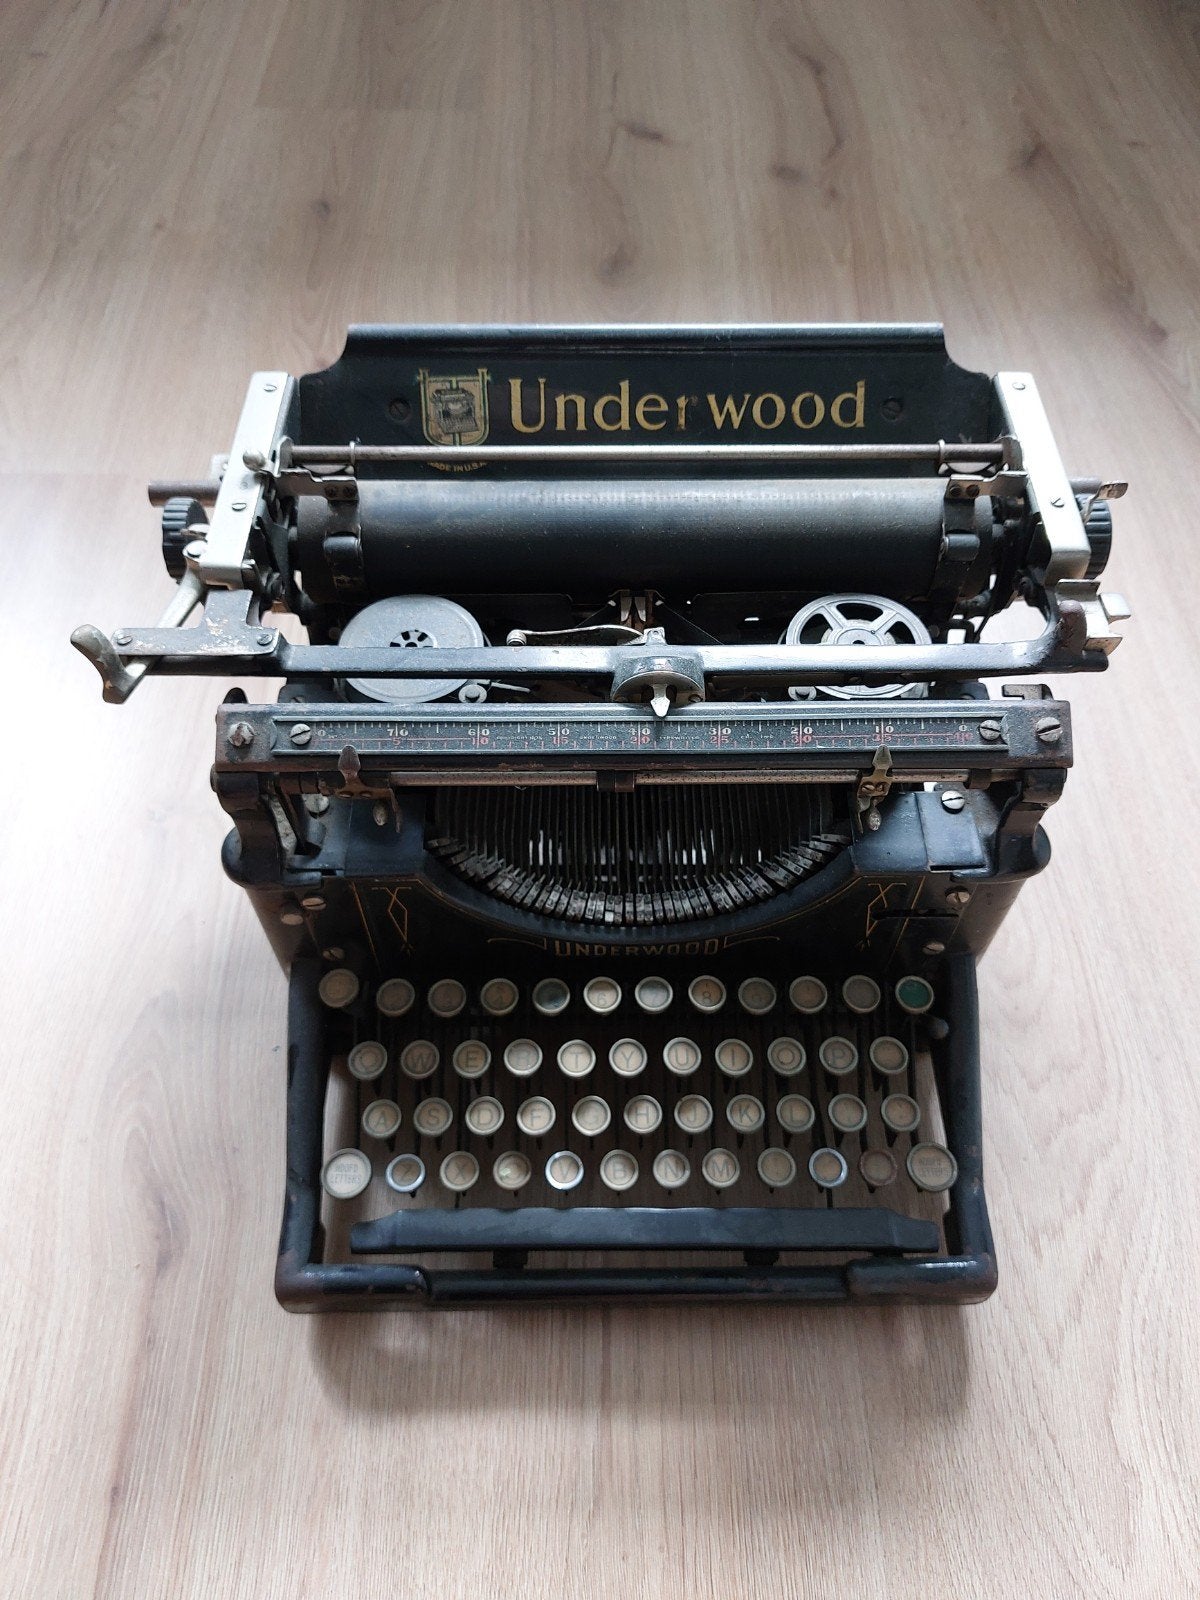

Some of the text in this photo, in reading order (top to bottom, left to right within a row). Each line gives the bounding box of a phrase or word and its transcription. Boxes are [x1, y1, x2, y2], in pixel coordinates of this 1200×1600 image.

[508, 378, 866, 433] Underwood
[387, 728, 409, 737] 70
[468, 728, 490, 736] 60
[548, 727, 570, 736] 50
[709, 727, 731, 735] 30
[791, 726, 813, 735] 20
[875, 725, 894, 734] 10
[710, 735, 729, 744] 25
[554, 938, 719, 956] UNDERWOOD
[466, 1050, 479, 1068] E
[569, 1051, 584, 1068] T
[621, 1050, 636, 1068] Y
[675, 1049, 689, 1066] U
[777, 1047, 795, 1066] O
[832, 1048, 846, 1065] P
[375, 1111, 388, 1130] A
[427, 1108, 442, 1127] S
[477, 1108, 493, 1125] D
[530, 1109, 542, 1126] F
[636, 1106, 649, 1124] H
[686, 1105, 698, 1122] J
[740, 1104, 753, 1123] K
[790, 1105, 802, 1122] L
[454, 1163, 467, 1179] X
[557, 1162, 572, 1178] V
[612, 1163, 626, 1179] B
[663, 1161, 679, 1178] N
[712, 1159, 730, 1178] M
